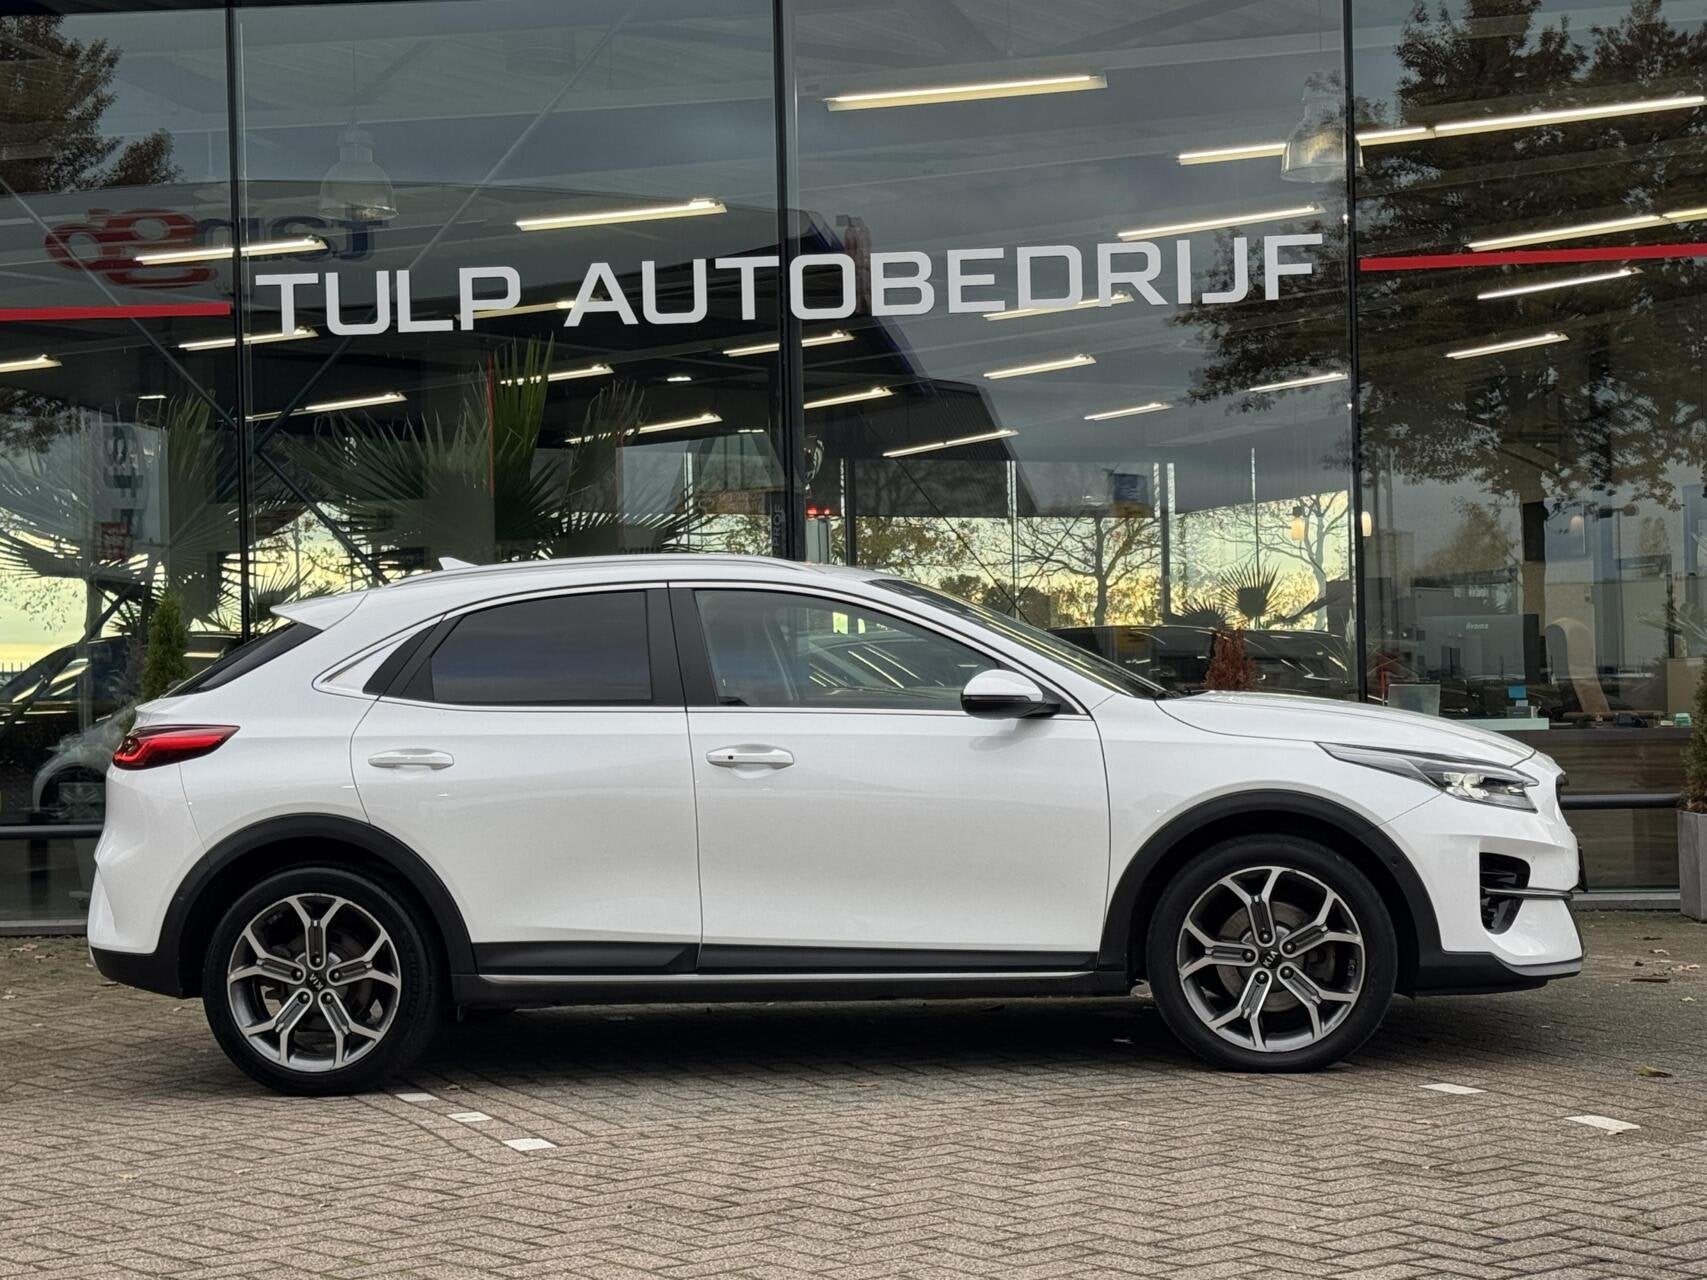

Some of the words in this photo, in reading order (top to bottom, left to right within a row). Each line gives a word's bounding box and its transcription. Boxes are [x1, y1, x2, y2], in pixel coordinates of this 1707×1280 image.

[255, 266, 521, 335] TULP
[564, 234, 1322, 327] AUTOBEDRIJF
[1263, 950, 1279, 967] KIA
[309, 973, 324, 990] KIA
